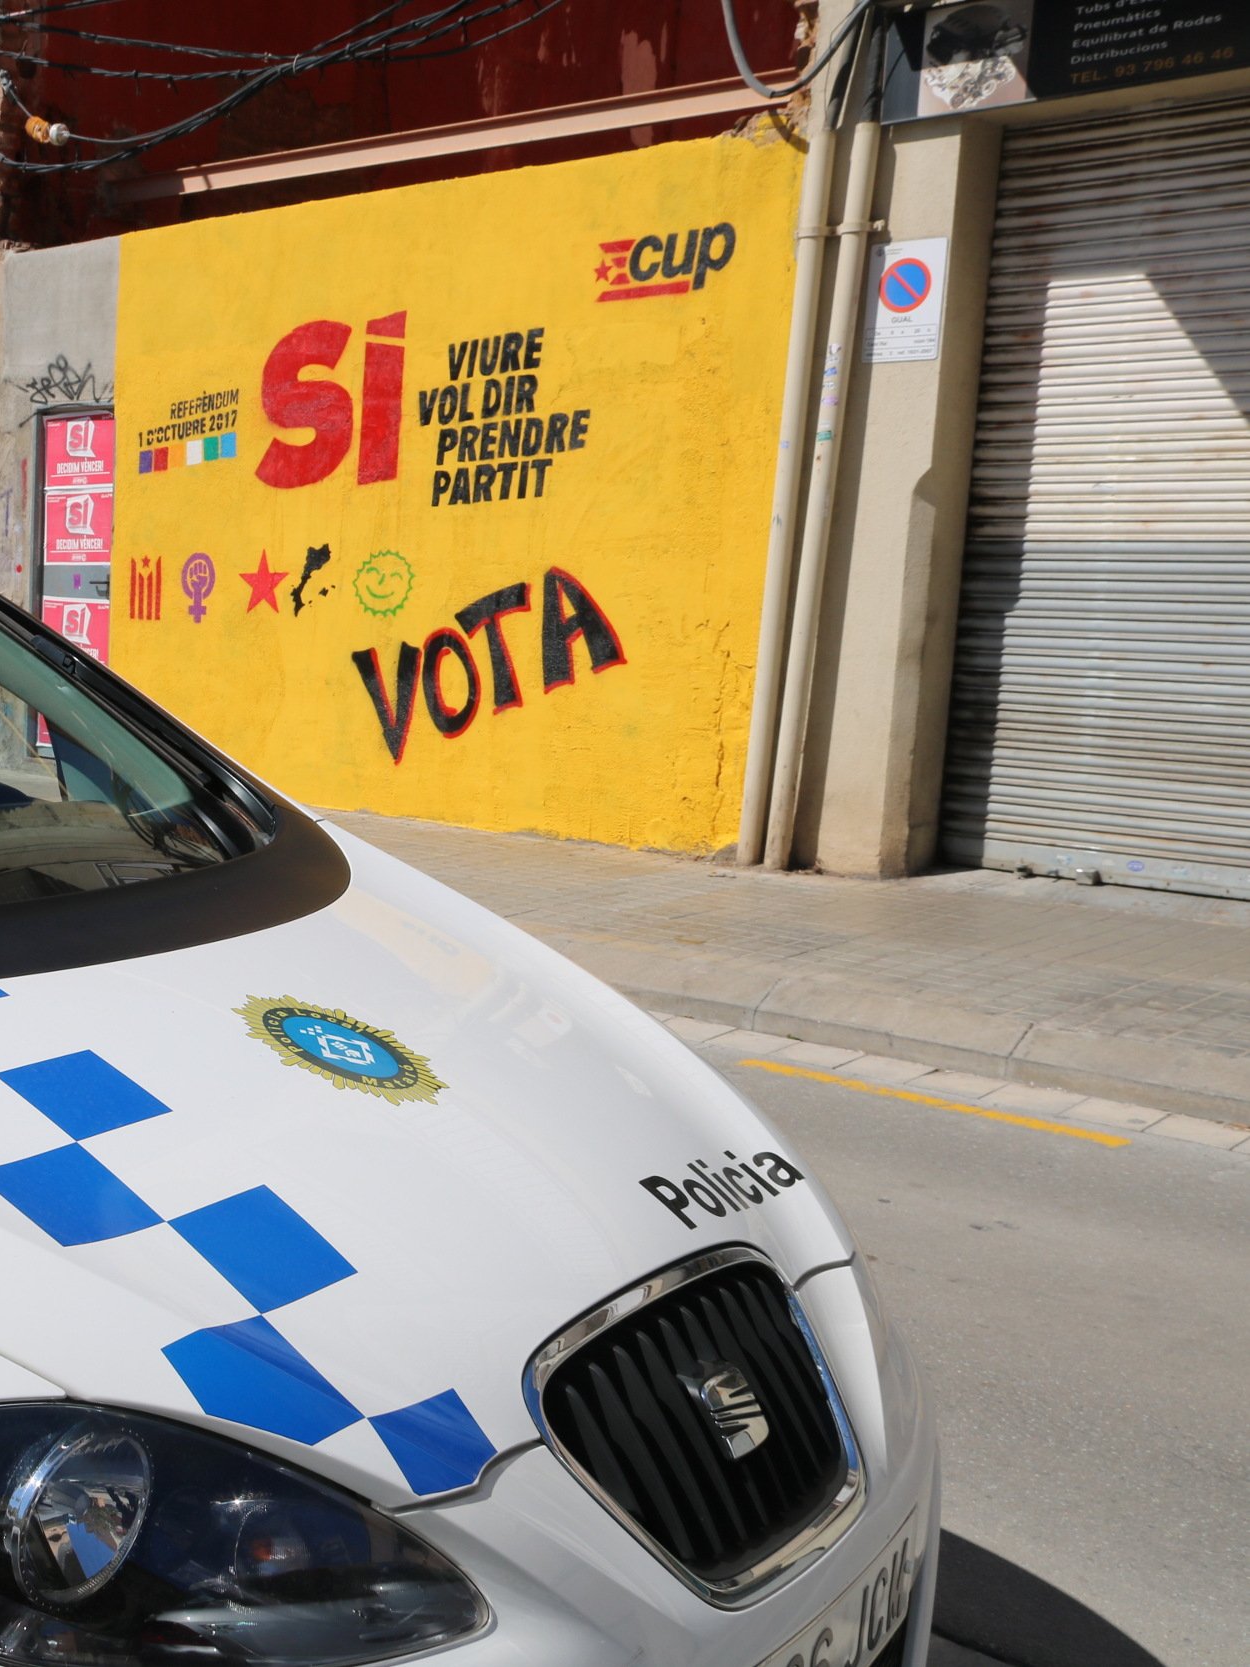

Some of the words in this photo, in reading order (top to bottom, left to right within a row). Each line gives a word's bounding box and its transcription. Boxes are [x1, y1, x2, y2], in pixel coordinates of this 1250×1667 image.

[1073, 8, 1161, 32] Pneumàtics
[1076, 3, 1110, 15] Tubs
[1071, 28, 1145, 49] Equilibrat
[1148, 24, 1168, 34] de
[1173, 13, 1223, 30] Rodes
[1070, 41, 1168, 65] Distribucions
[1114, 63, 1136, 78] 93
[448, 327, 545, 381] VIURE
[418, 382, 476, 427] VOL
[481, 374, 539, 419] DIR
[146, 417, 206, 446] D'OCTUBRE
[208, 410, 238, 432] 2017
[436, 409, 591, 465] PRENDRE
[56, 462, 80, 475] DECIDIM
[431, 459, 553, 507] PARTIT
[56, 539, 79, 550] DECIDIM
[351, 566, 628, 766] VOTA
[268, 1010, 304, 1053] Policia
[361, 1064, 416, 1088] Mataró
[638, 1150, 806, 1231] Policia
